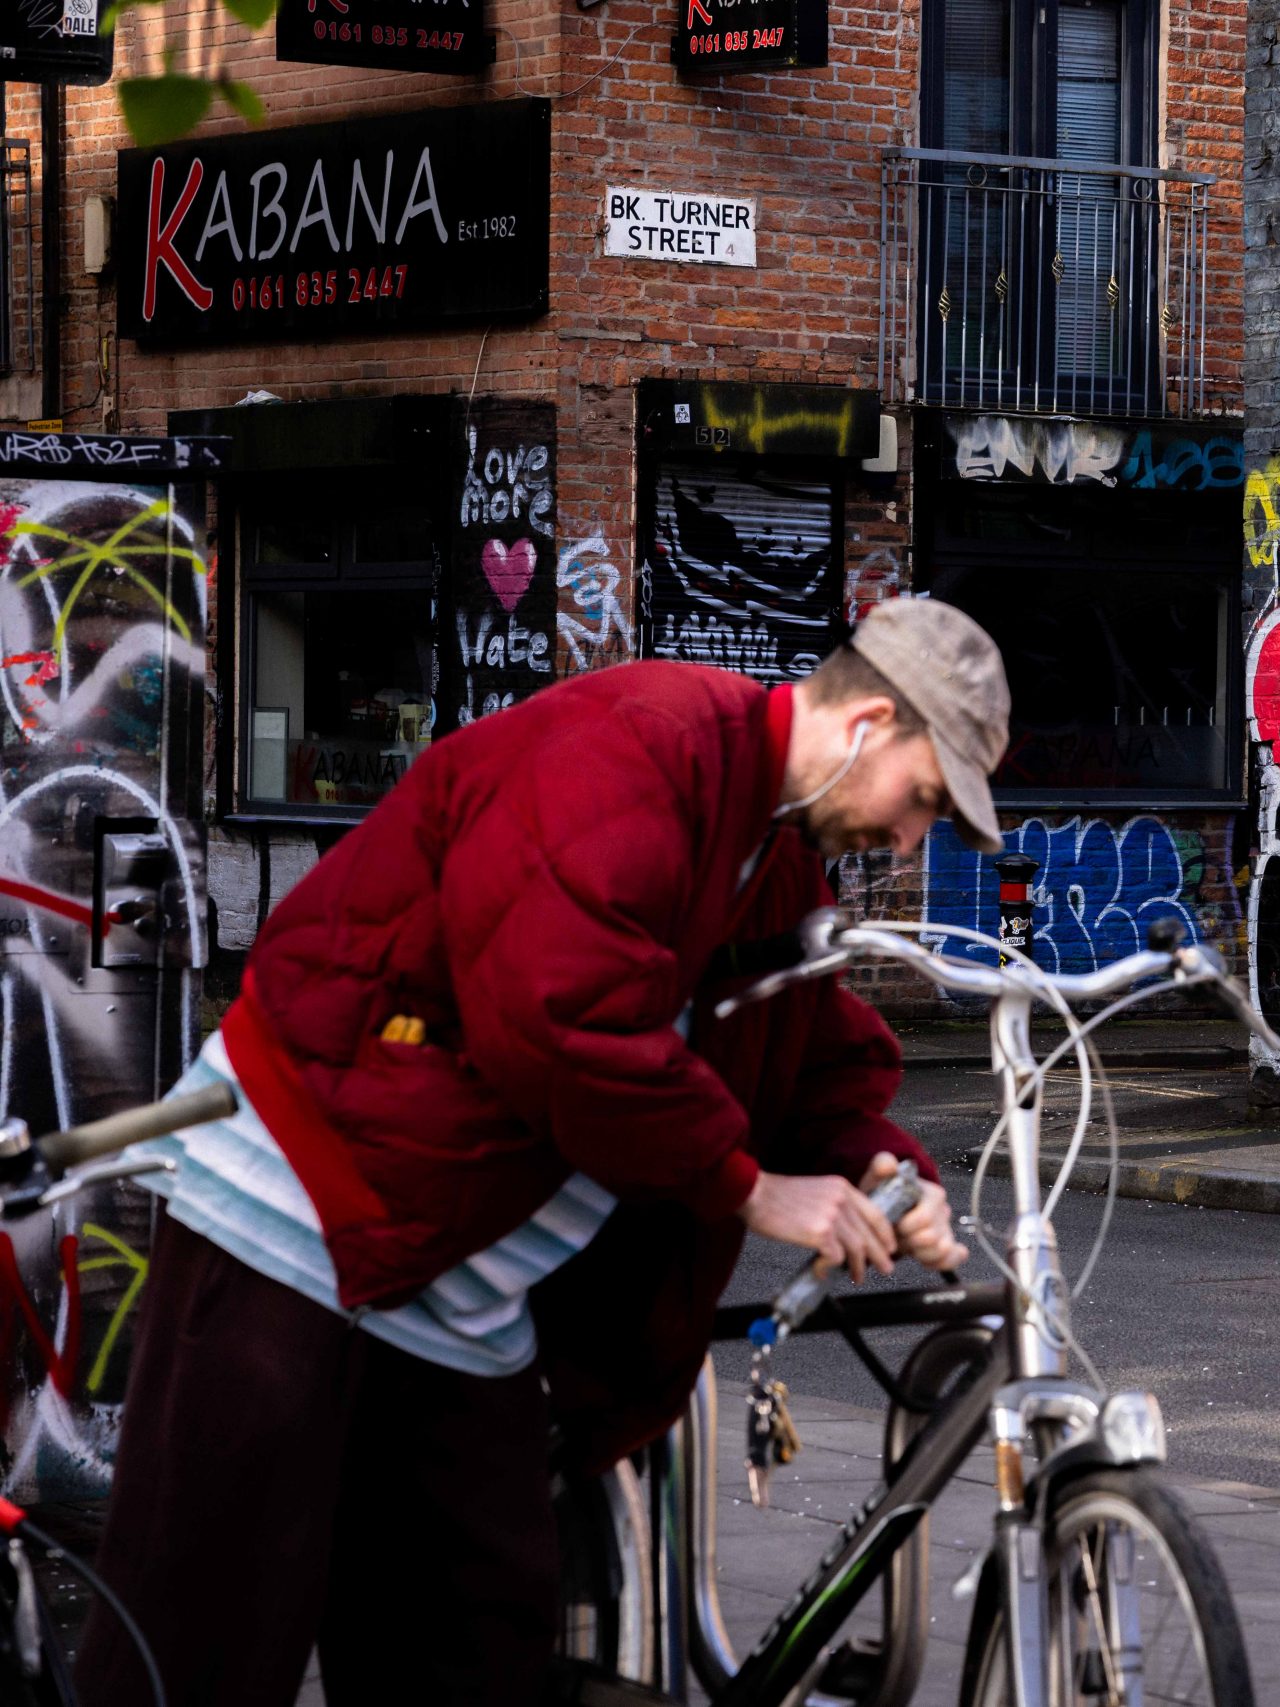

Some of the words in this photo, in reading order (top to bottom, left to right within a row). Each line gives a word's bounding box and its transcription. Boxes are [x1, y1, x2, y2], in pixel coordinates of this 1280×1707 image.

[314, 20, 362, 42] 0161
[372, 25, 408, 46] 835
[416, 29, 464, 50] 2447
[690, 34, 720, 54] 0161
[725, 31, 748, 52] 835
[753, 27, 784, 48] 2447
[611, 195, 645, 221] BK.
[654, 198, 750, 229] TURNER
[143, 147, 449, 322] KABANA
[628, 225, 720, 255] STREET
[725, 244, 735, 257] 4
[232, 275, 284, 311] 0161
[296, 270, 337, 306] 835
[348, 264, 408, 303] 2447
[460, 481, 554, 537] more
